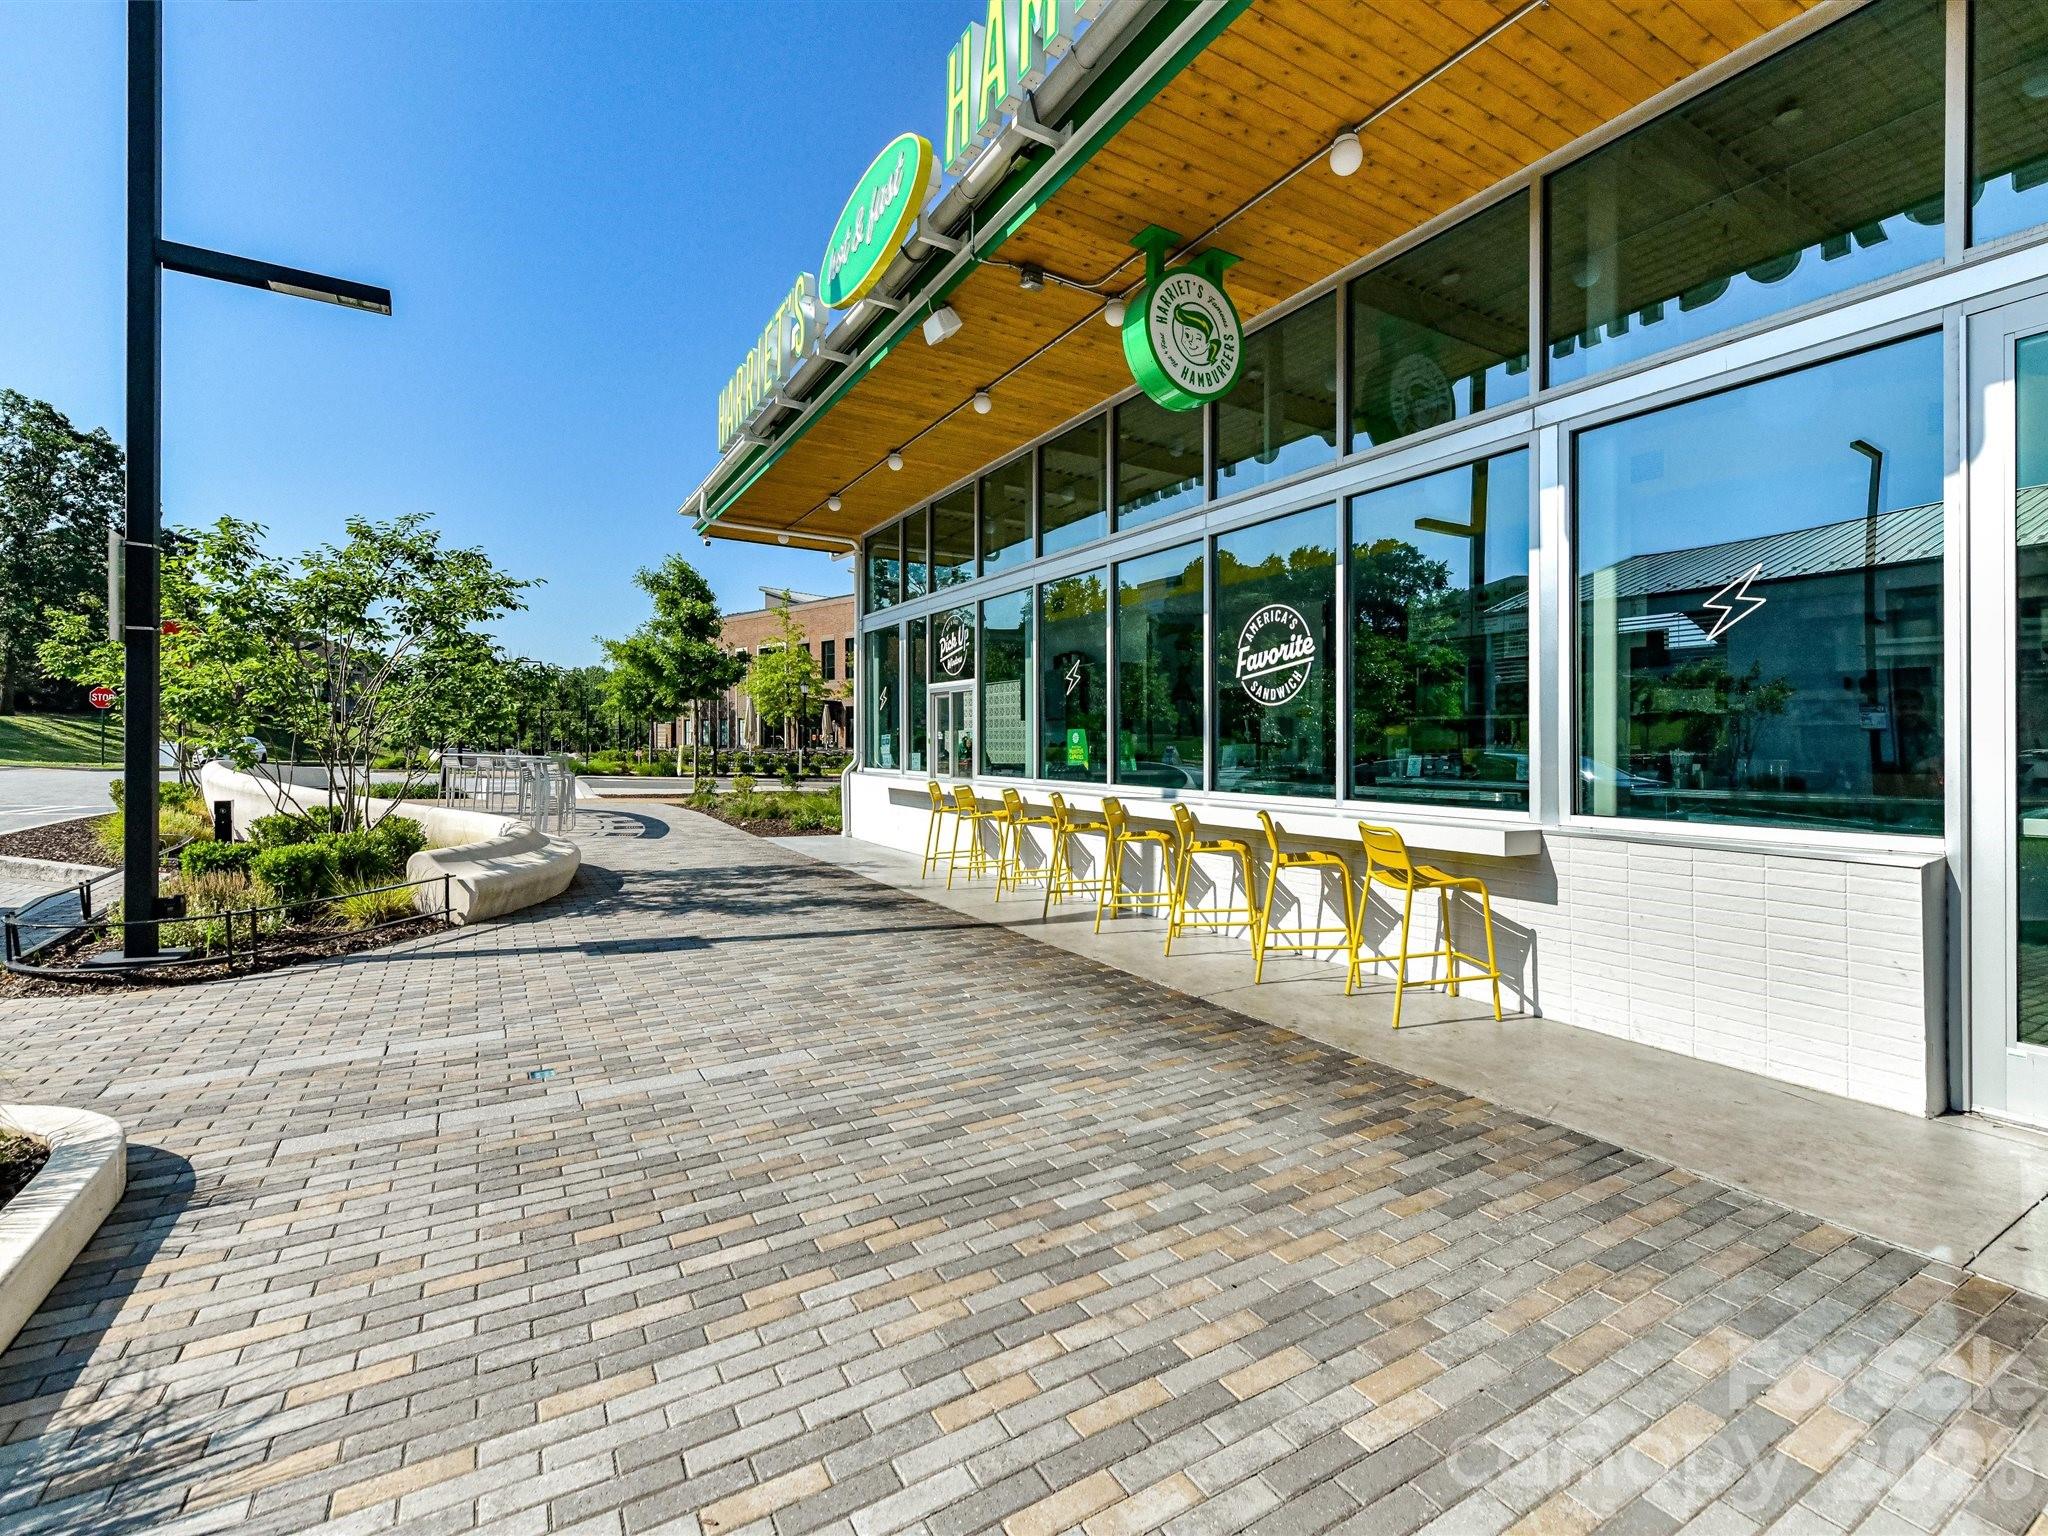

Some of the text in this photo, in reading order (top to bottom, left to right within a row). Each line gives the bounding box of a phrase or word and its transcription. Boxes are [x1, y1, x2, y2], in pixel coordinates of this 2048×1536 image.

[1156, 279, 1204, 325] HARRIET'S
[1207, 296, 1229, 329] Famous
[718, 271, 810, 453] HARRIET'S
[1181, 333, 1235, 388] HAMBURGERS
[939, 632, 957, 658] Pick
[958, 623, 969, 651] Up
[1245, 609, 1298, 642] AMERICA'S
[1236, 634, 1316, 678] Favorite
[91, 693, 115, 702] STOP
[1250, 670, 1303, 700] SANDWICH
